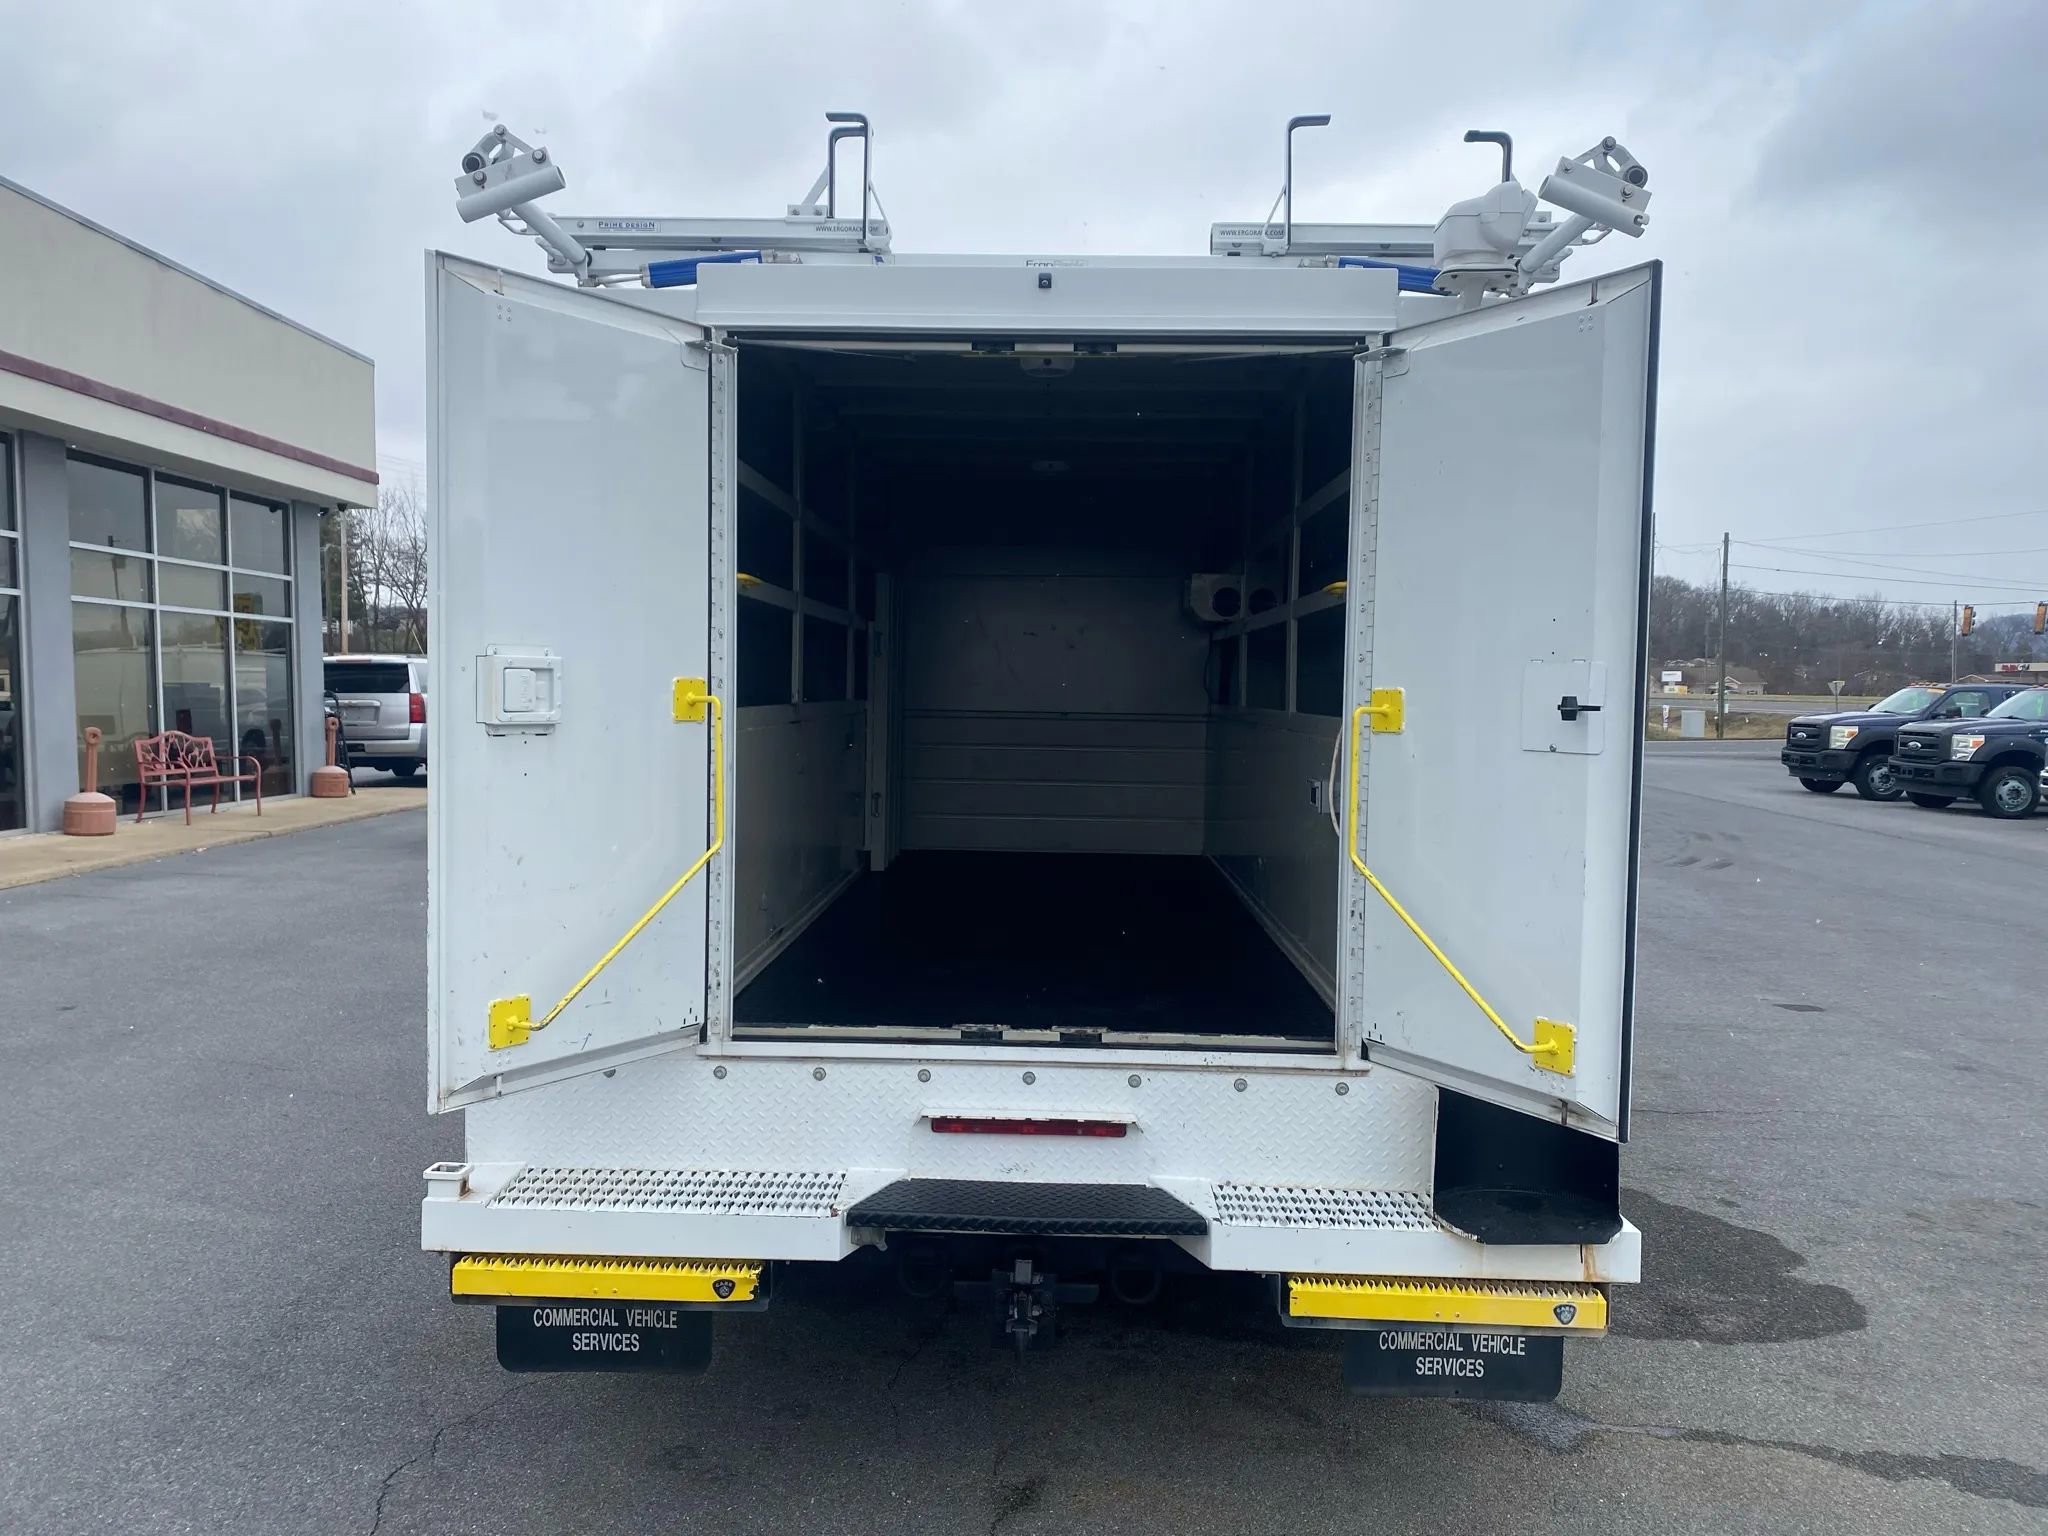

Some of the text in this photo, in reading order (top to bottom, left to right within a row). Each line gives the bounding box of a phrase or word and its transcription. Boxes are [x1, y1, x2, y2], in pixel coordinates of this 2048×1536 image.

[533, 1308, 678, 1328] COMMERCIAL VEHICLE
[572, 1332, 640, 1352] SERVICES
[1379, 1331, 1526, 1356] COMMERCIAL VEHICLE
[1416, 1356, 1485, 1377] SERVICES
